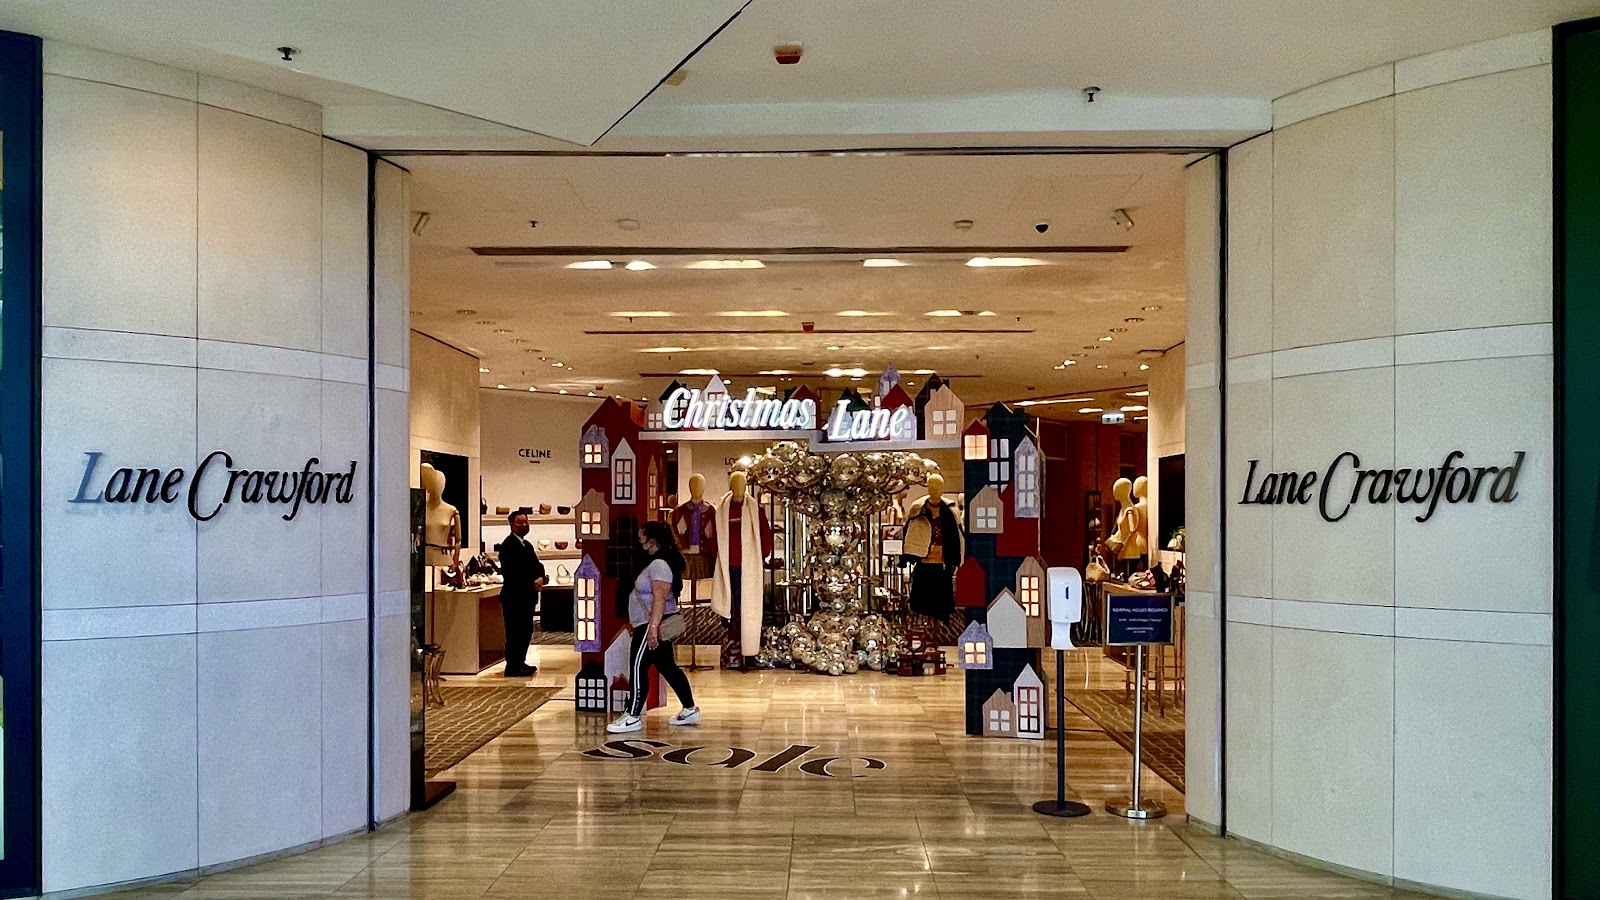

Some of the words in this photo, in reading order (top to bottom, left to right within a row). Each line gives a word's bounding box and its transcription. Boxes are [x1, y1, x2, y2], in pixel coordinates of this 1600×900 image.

[662, 387, 814, 429] Christmas
[828, 399, 908, 441] Lane
[518, 449, 552, 458] CELINE
[67, 451, 185, 504] Lane
[187, 450, 357, 521] Crawford
[1238, 459, 1318, 505] Lane
[1318, 450, 1526, 523] Crawford
